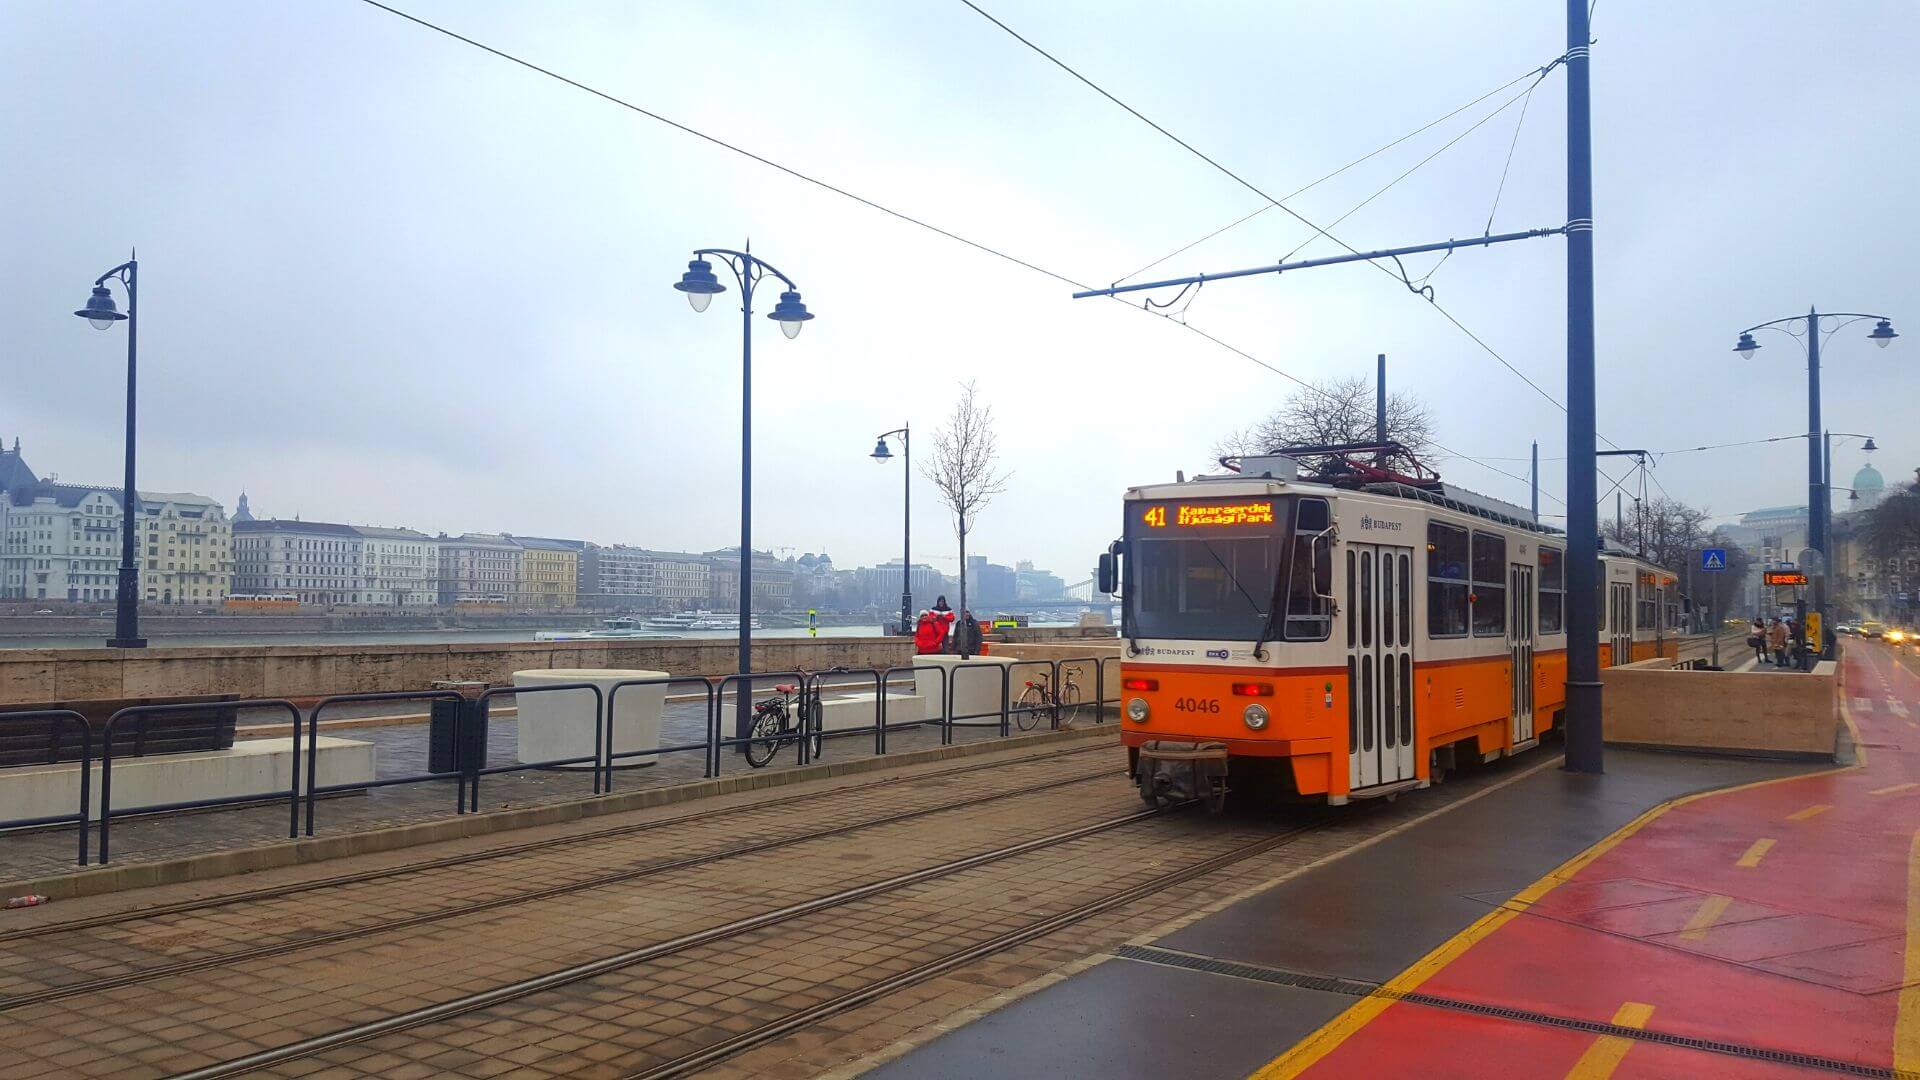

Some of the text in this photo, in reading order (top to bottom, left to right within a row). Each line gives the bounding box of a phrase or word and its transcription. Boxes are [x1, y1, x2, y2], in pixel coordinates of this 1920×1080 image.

[1144, 506, 1167, 527] 41
[1238, 513, 1273, 523] Park
[1373, 520, 1402, 531] BUDAPEST
[1157, 648, 1195, 656] BUDAPEST
[1175, 697, 1220, 714] 4046
